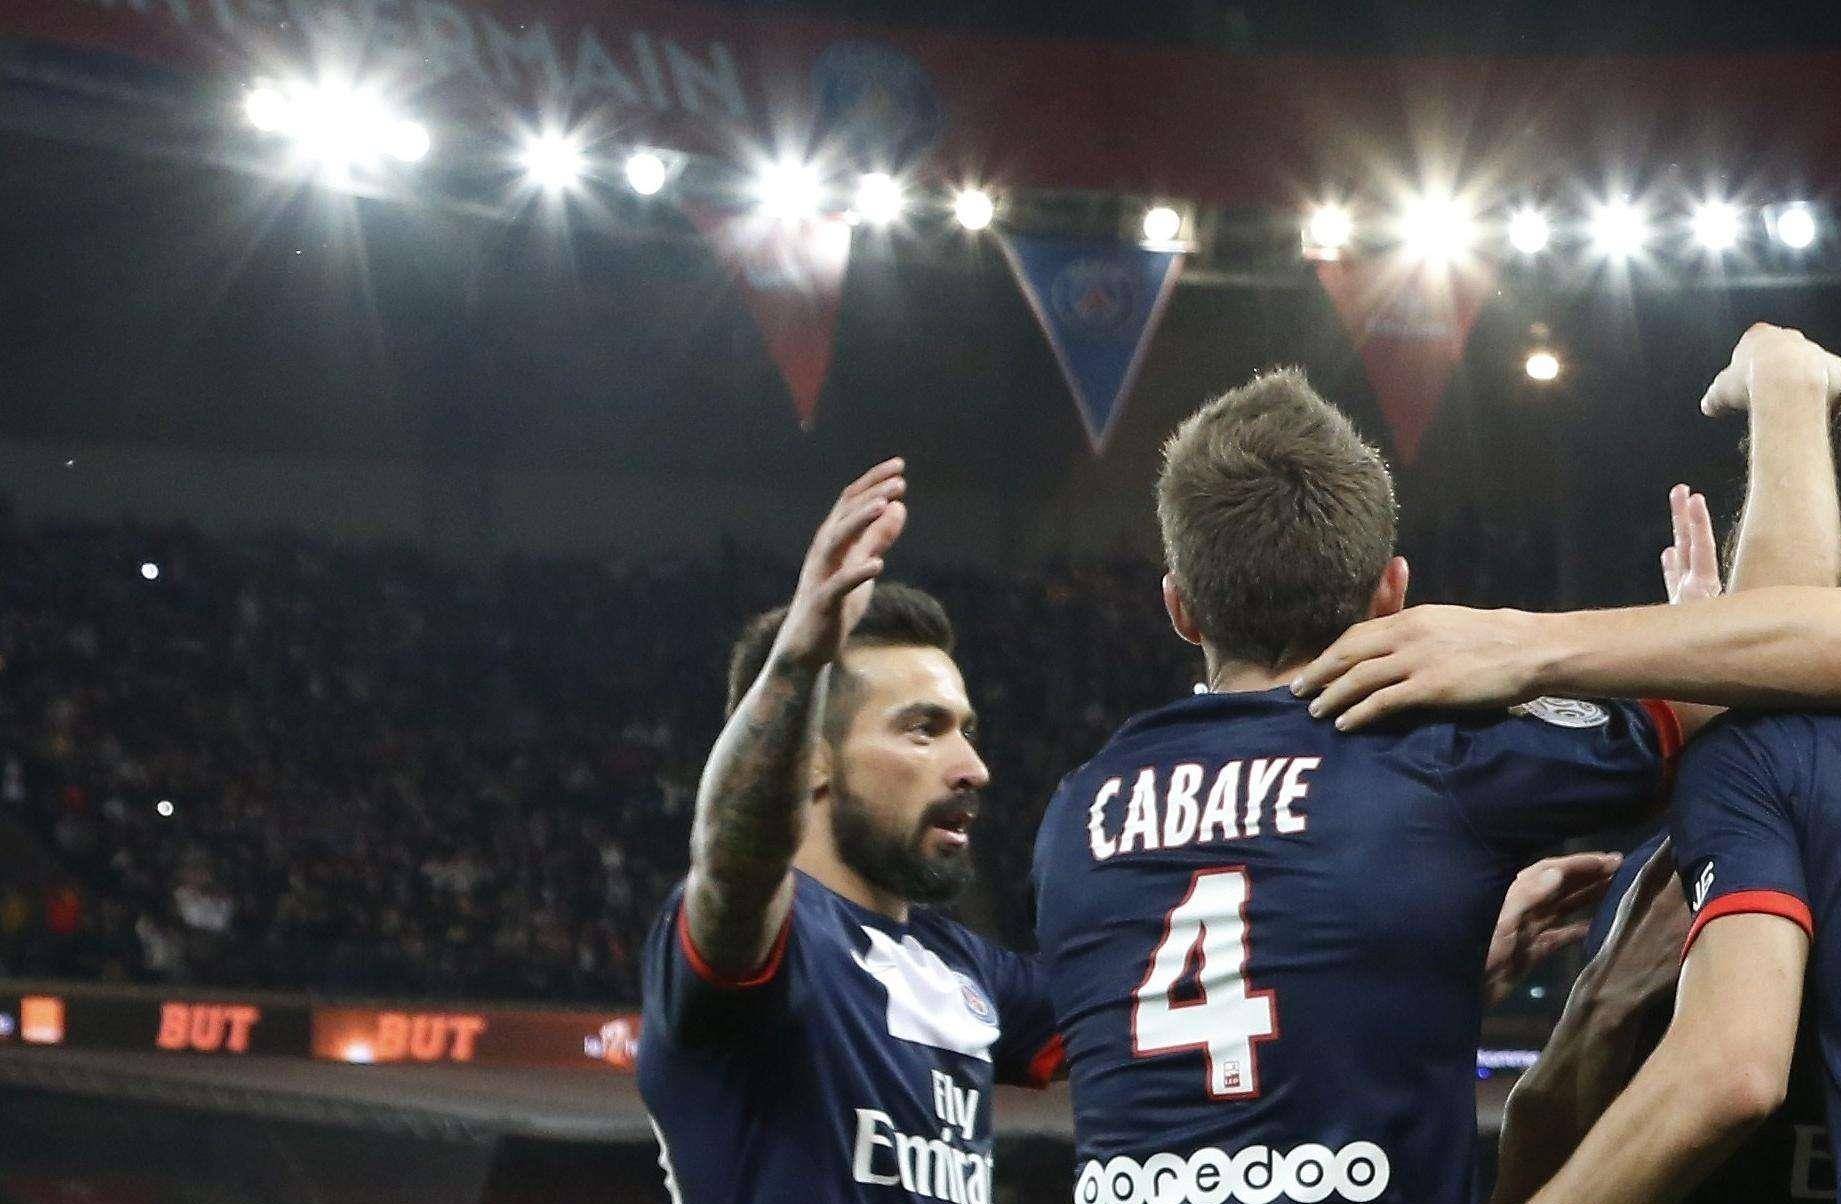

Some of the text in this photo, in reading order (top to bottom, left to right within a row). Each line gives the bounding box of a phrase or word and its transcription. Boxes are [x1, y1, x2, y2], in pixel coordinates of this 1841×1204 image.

[1087, 757, 1322, 862] CABAYE
[1131, 864, 1279, 1101] 4
[157, 1003, 260, 1053] BUT
[377, 1012, 487, 1063] BUT
[931, 1069, 979, 1140] Fly
